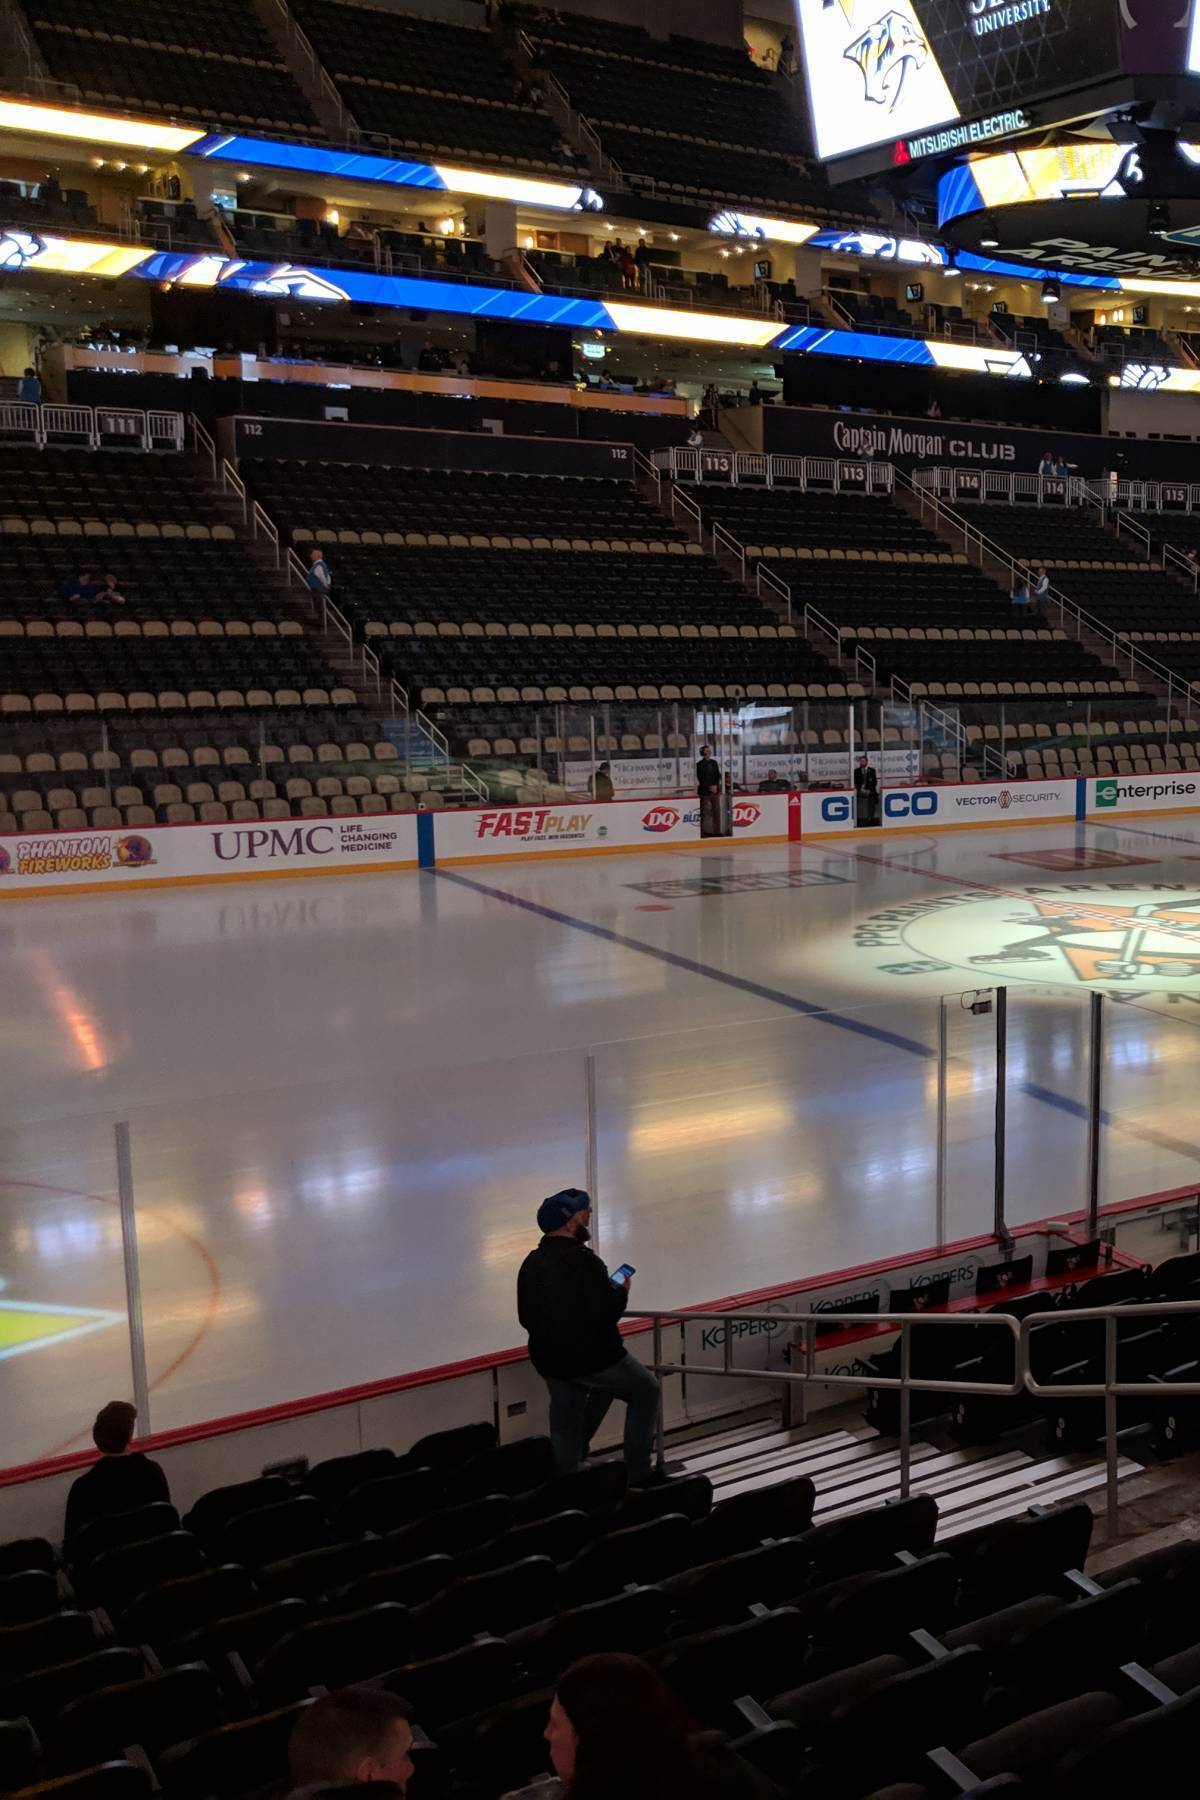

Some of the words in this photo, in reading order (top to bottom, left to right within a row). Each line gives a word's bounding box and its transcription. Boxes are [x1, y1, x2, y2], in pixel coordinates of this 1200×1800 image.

[974, 0, 1051, 36] UNIVERSITY
[909, 127, 968, 159] MITSUBISHI
[970, 110, 1026, 142] ELECTRIC
[106, 417, 136, 434] 111
[244, 423, 263, 435] 112
[834, 421, 886, 453] Captain
[888, 428, 943, 459] Morgan
[950, 440, 1015, 460] CLUB
[611, 448, 628, 459] 112
[705, 456, 729, 472] 113
[843, 466, 864, 481] 113
[959, 474, 979, 488] 114
[1047, 481, 1065, 495] 114
[1165, 488, 1185, 502] 115
[1100, 781, 1196, 800] enterprise
[821, 791, 938, 822] GCO
[956, 796, 997, 807] VECTOR
[1013, 792, 1061, 803] SECURITY
[649, 811, 675, 828] DQ
[732, 808, 756, 823] DQ
[341, 825, 363, 833] LIFE
[211, 826, 334, 860] UPMC
[341, 832, 397, 843] CHANGING
[17, 836, 111, 859] PHANTOM
[341, 842, 392, 852] MEDICINE
[18, 855, 111, 874] FIREWORKS
[701, 1318, 778, 1351] KOPPERS
